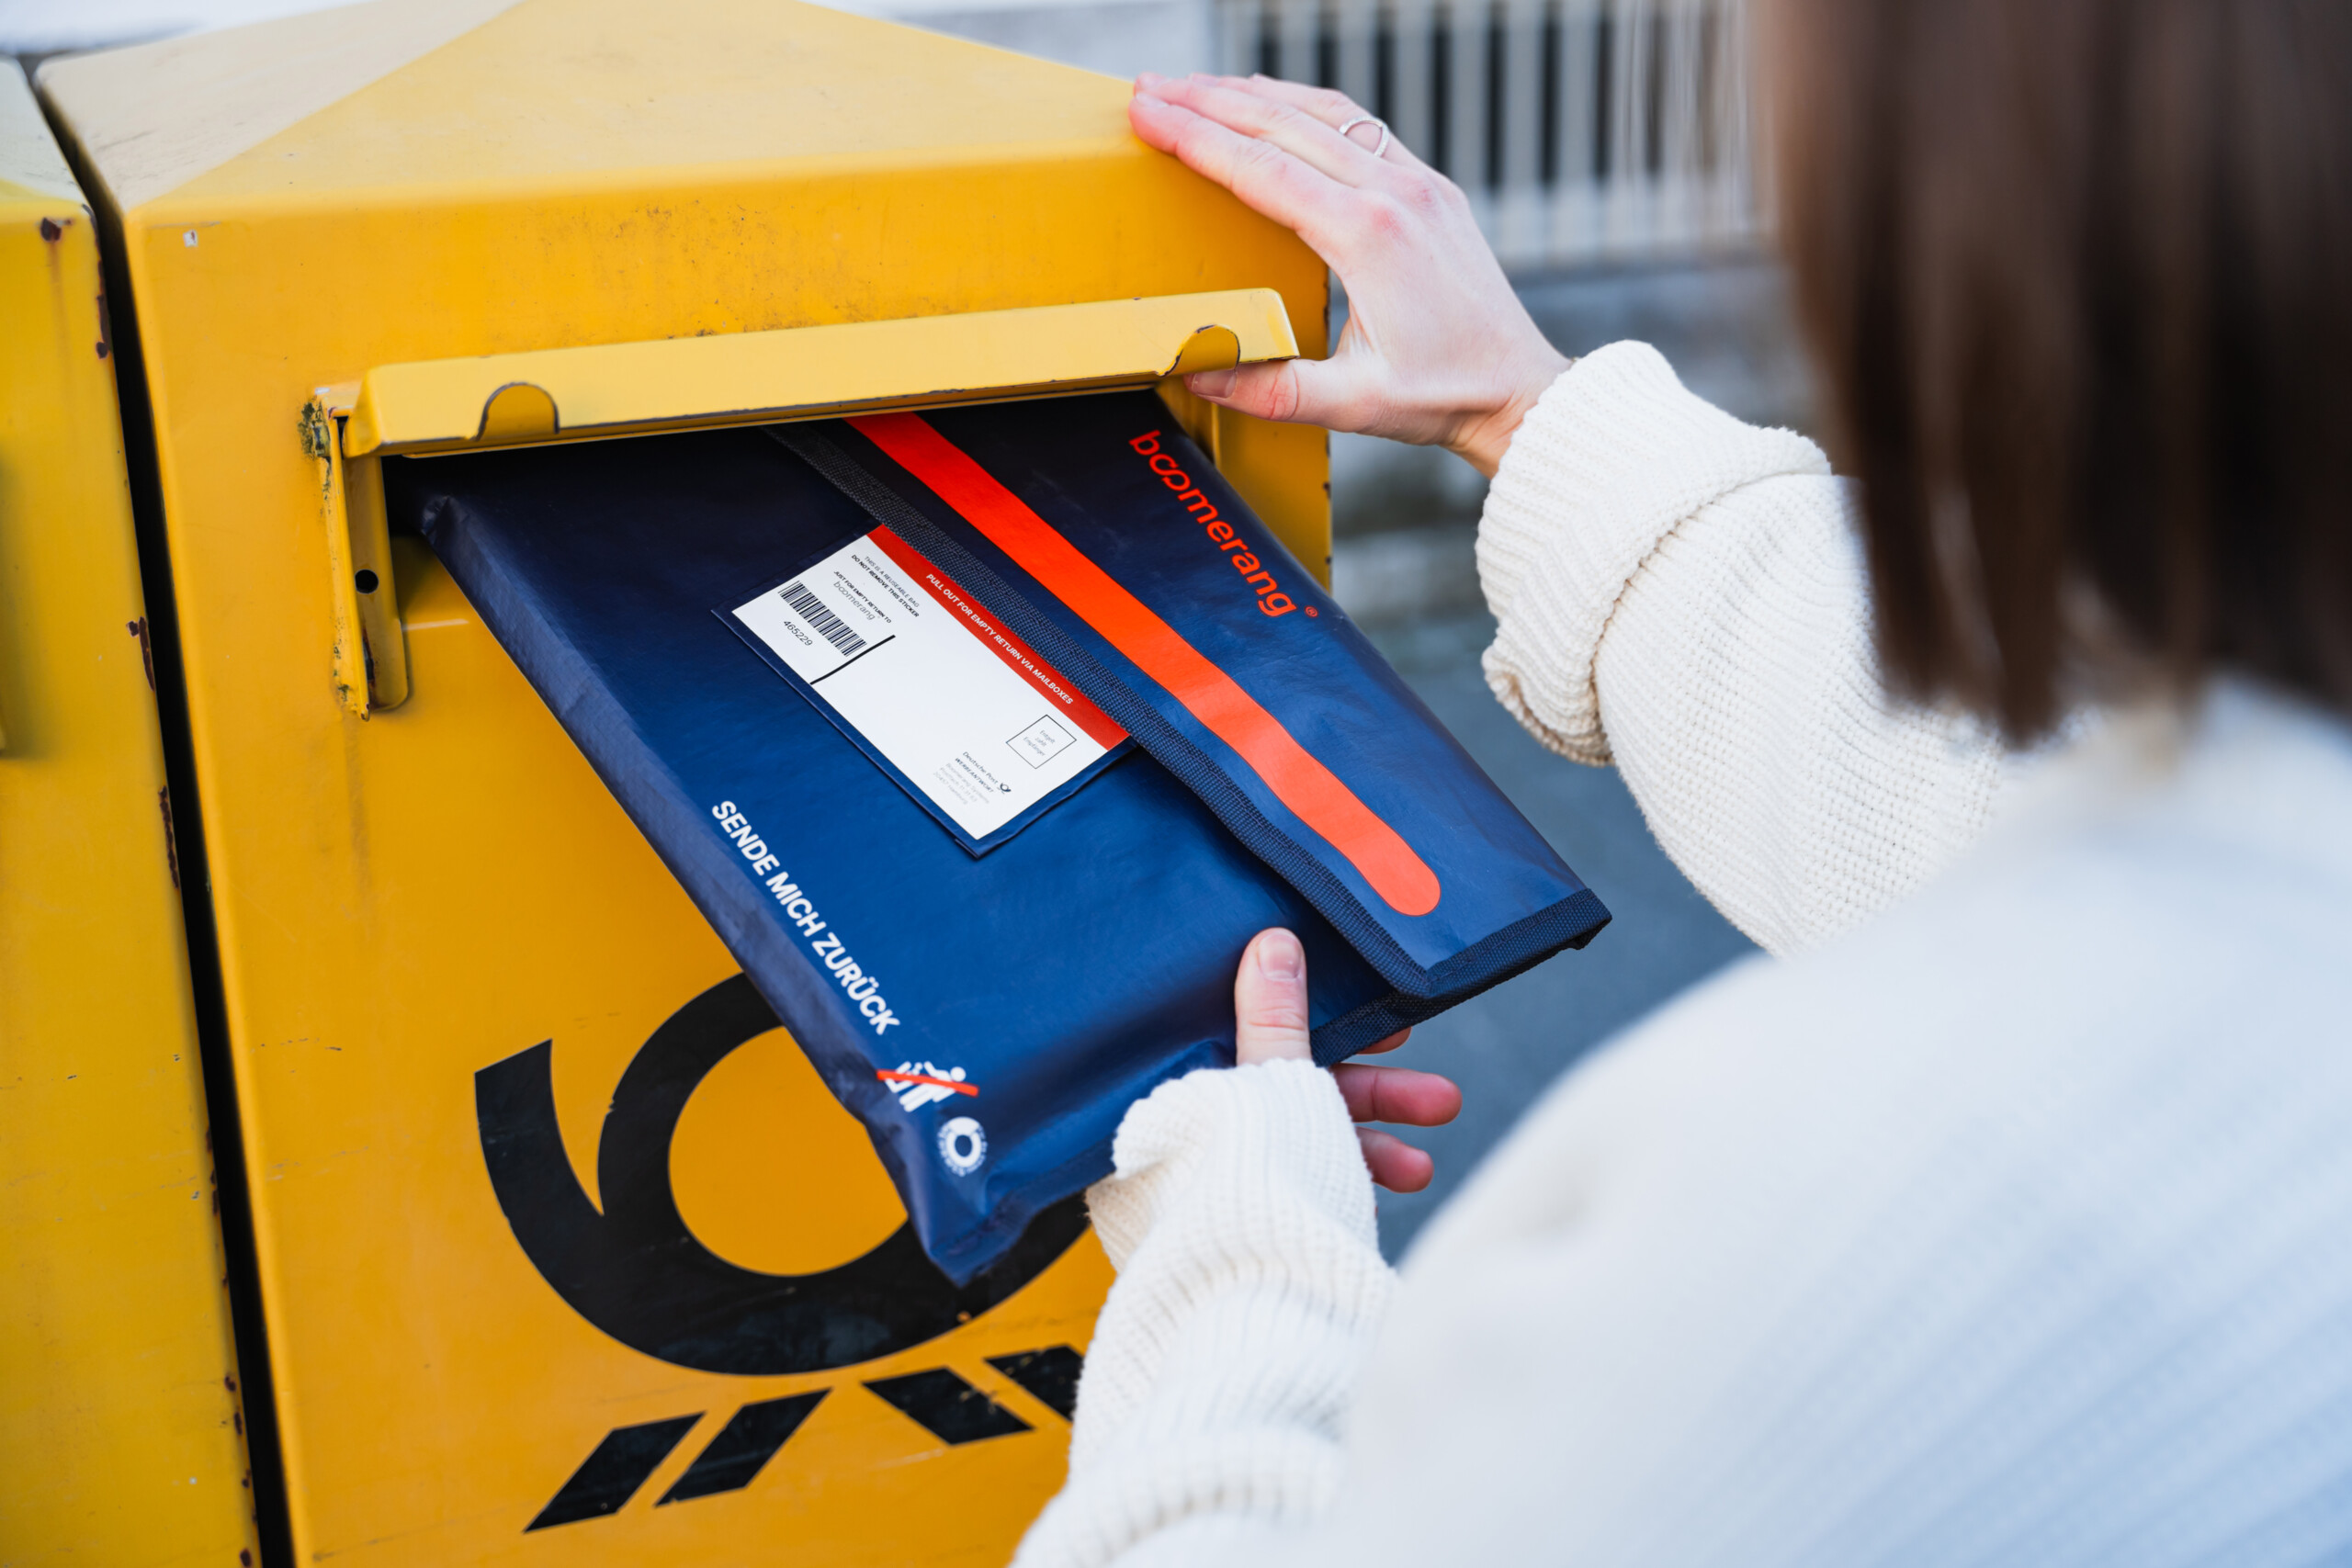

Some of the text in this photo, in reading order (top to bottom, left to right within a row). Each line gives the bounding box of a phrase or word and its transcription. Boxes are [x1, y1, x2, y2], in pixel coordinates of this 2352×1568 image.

[833, 571, 846, 581] JUST
[844, 580, 854, 590] FOR
[853, 588, 869, 602] EMPTY
[867, 602, 886, 617] RETURN
[851, 554, 919, 617] DO NOT REMOVE THIS STICKER
[865, 556, 876, 567] THIS
[883, 574, 910, 598] REUSEABLE
[908, 597, 920, 607] BAG
[784, 621, 813, 646] 465229
[926, 573, 1073, 705] PULL OUT FOR EMPTY RETURN VIA MAILBOXES
[963, 751, 1000, 784] Deutsche Post
[712, 801, 900, 1035] SENDE MICH ZURÜCK
